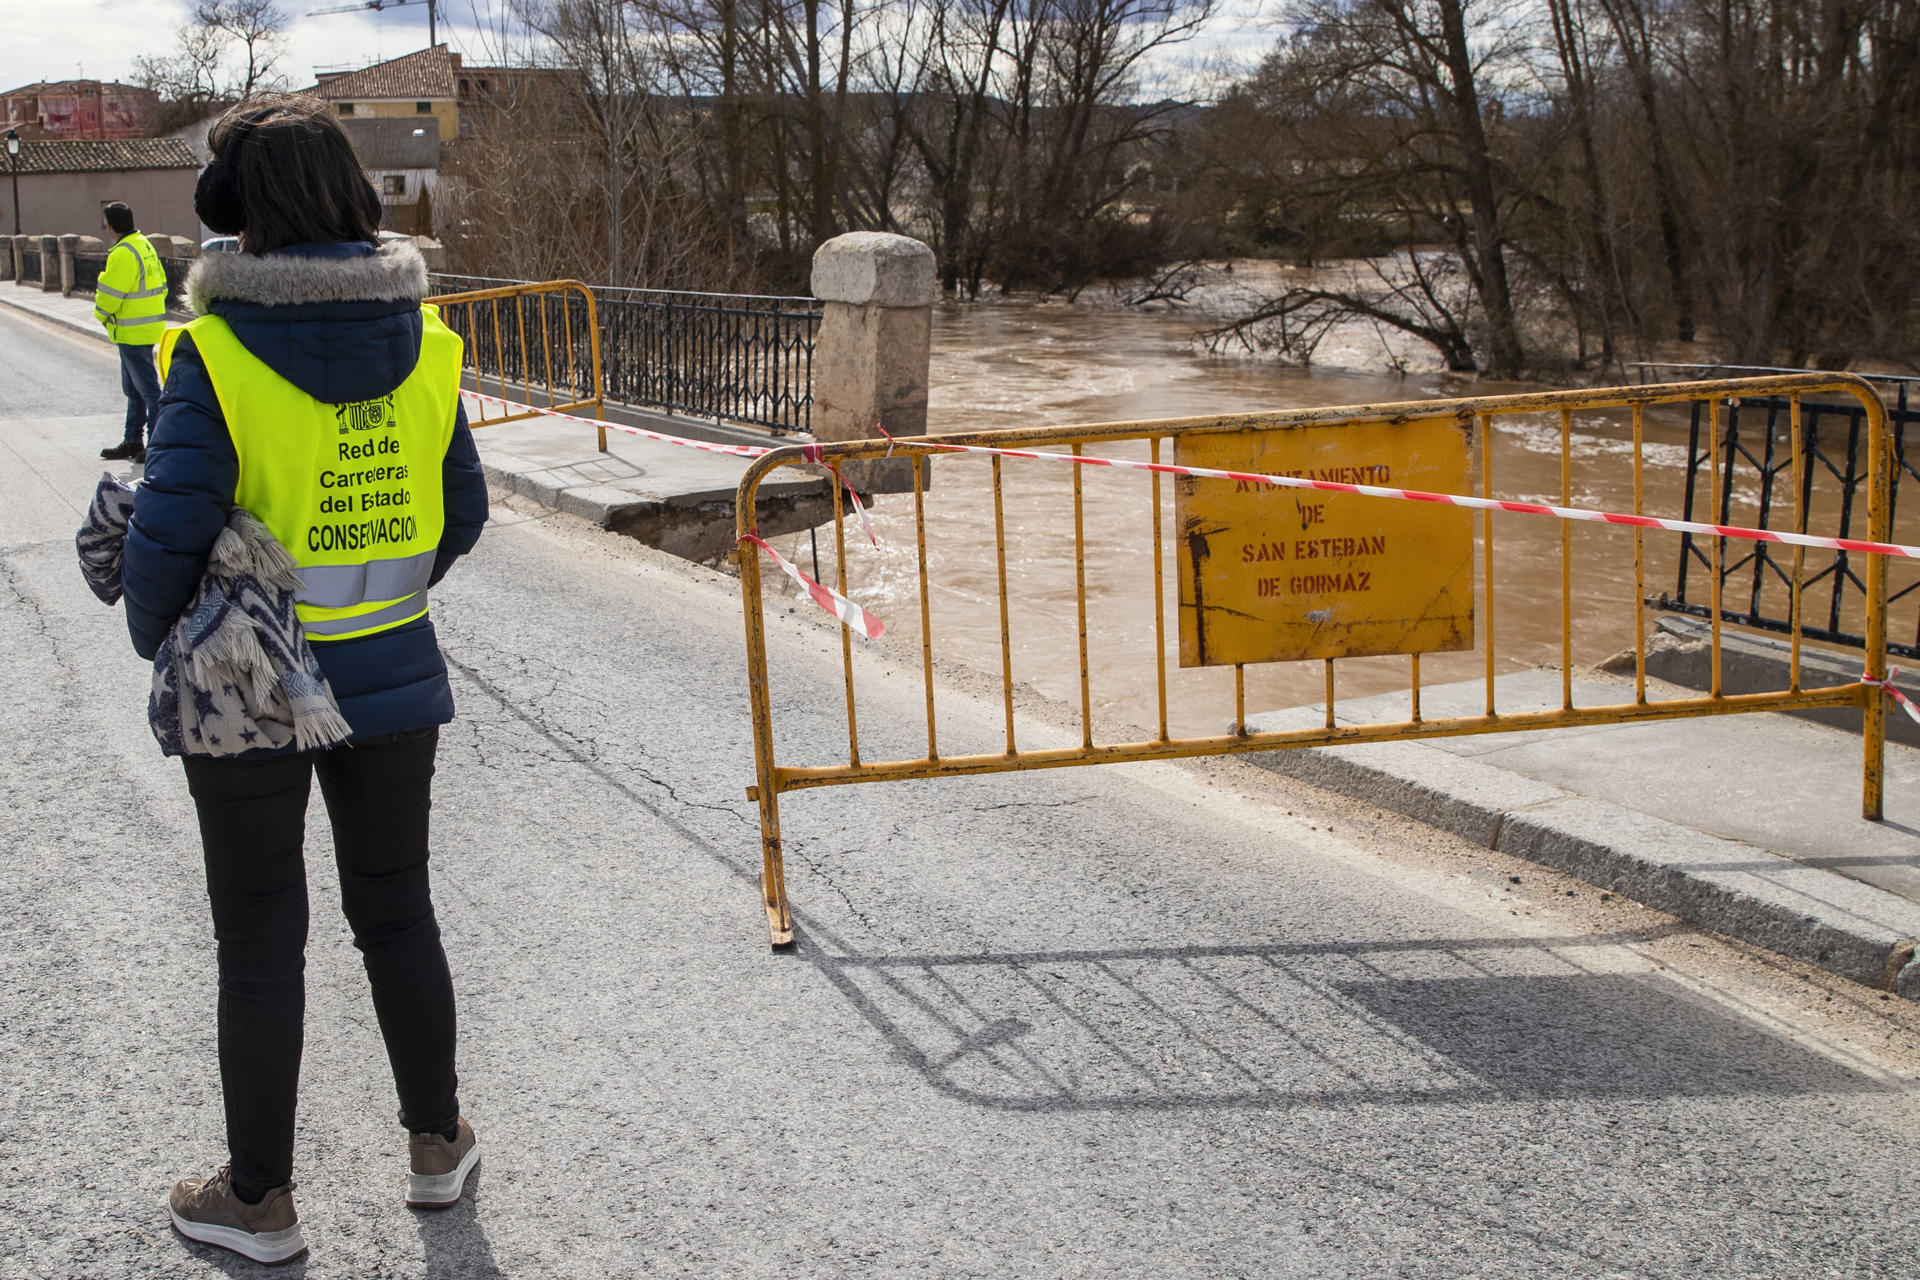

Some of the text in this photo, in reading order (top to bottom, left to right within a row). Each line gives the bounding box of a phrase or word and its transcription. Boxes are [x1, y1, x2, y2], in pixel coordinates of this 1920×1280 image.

[339, 436, 399, 461] Red de
[320, 488, 411, 513] del Estado
[1302, 504, 1324, 524] DE
[1242, 536, 1386, 563] SAN ESTEBAN
[1258, 571, 1371, 597] DE GORMAZ
